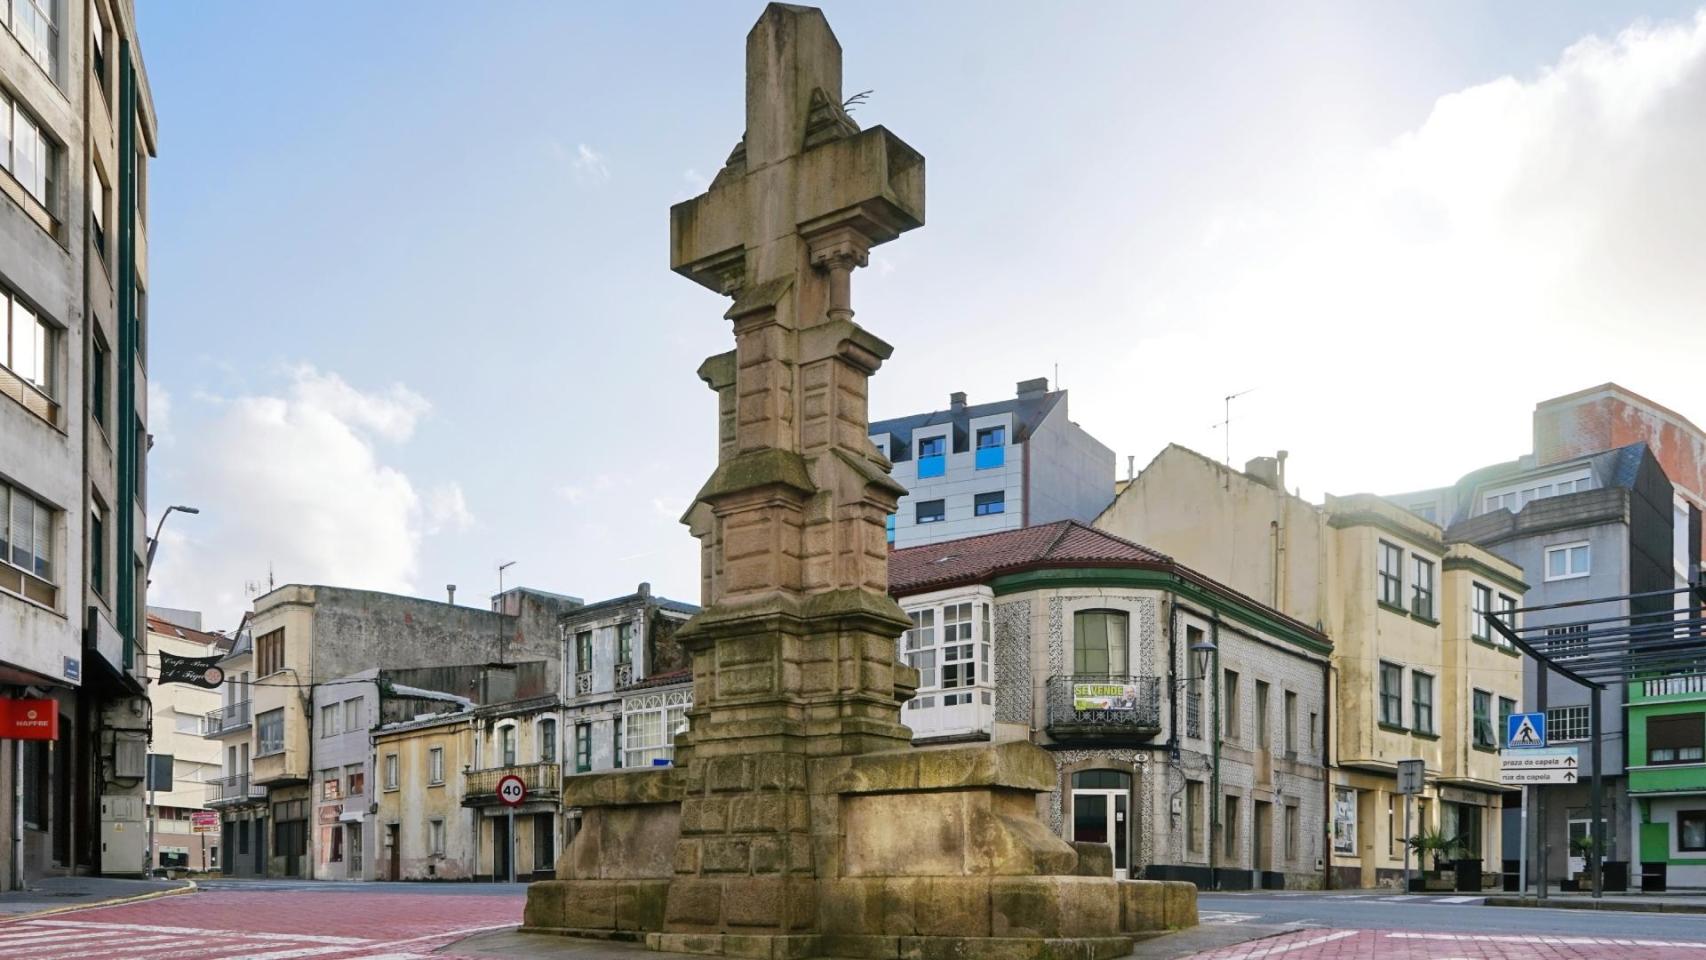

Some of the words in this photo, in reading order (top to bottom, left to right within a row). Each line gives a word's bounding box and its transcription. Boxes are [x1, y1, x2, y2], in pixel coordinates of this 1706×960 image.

[1075, 685, 1089, 696] SE
[1090, 685, 1123, 697] VENDE
[1535, 758, 1559, 766] capela
[503, 785, 521, 796] 40
